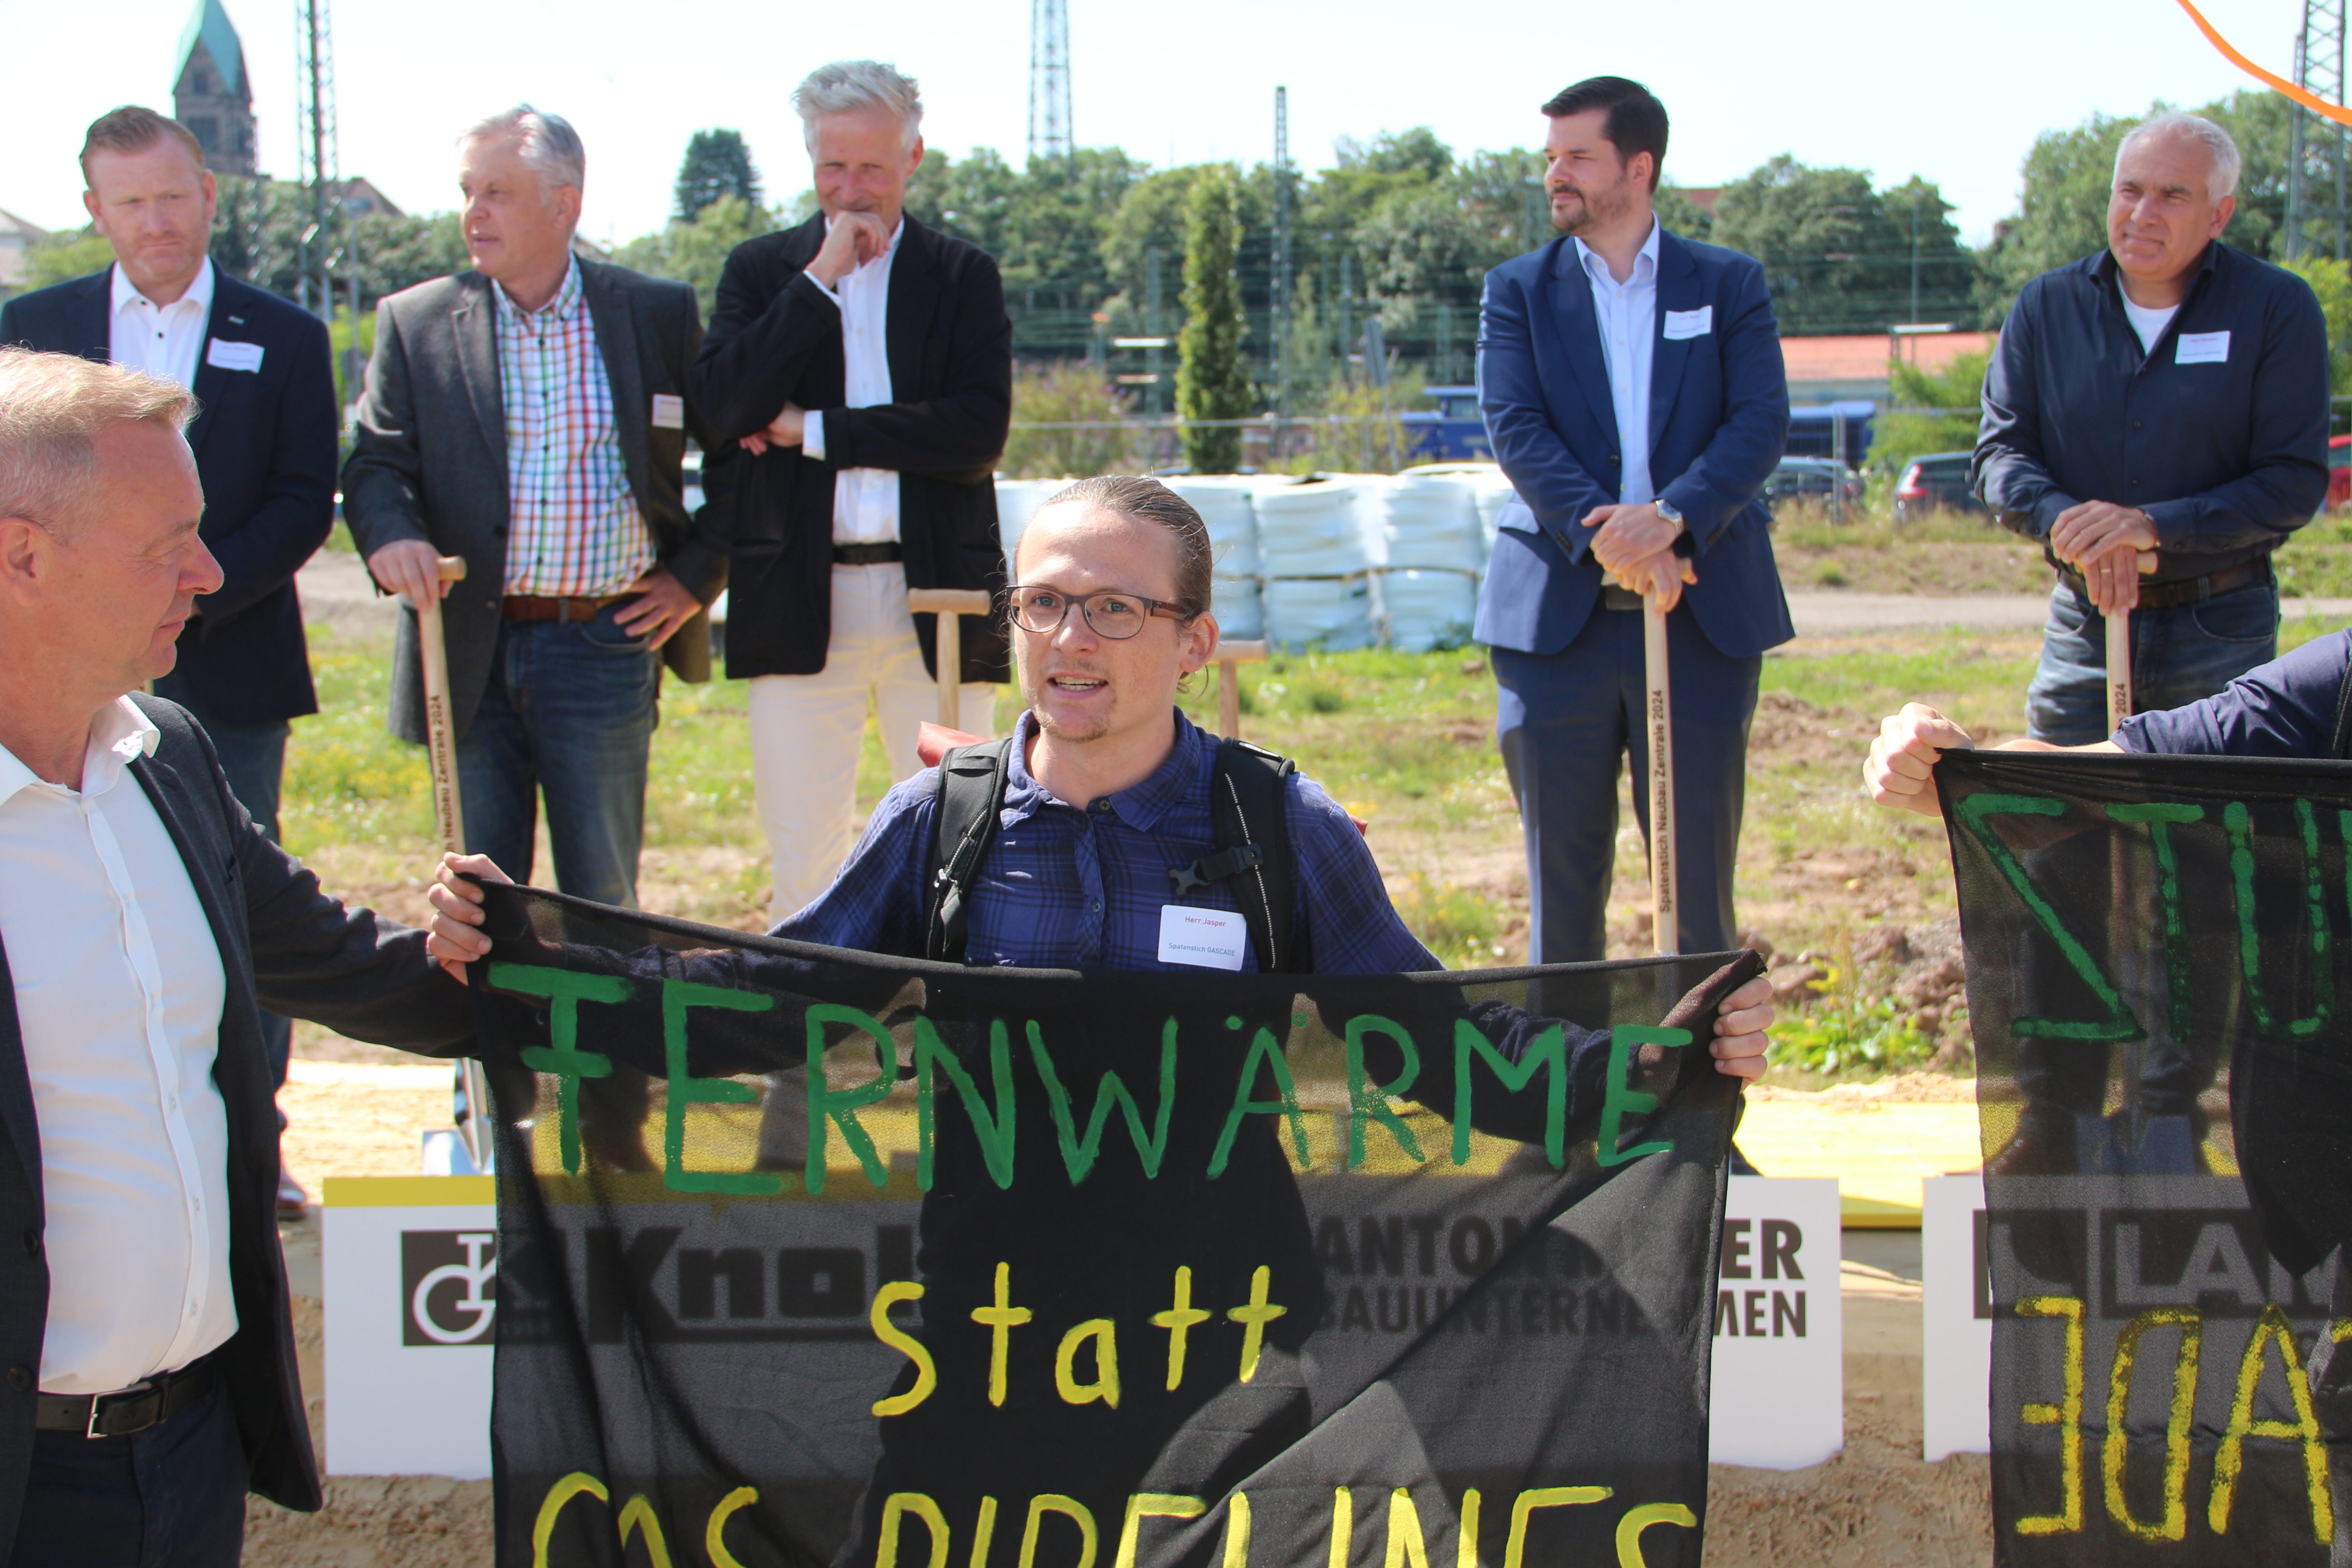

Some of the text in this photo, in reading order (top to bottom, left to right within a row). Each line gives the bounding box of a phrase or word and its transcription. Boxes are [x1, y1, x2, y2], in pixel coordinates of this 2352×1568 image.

[430, 694, 443, 725] 2024
[2115, 682, 2127, 713] 2024
[434, 730, 449, 783] Zentrale
[441, 788, 453, 838] Neubau
[1652, 689, 1671, 913] Spatenstich Neubau Zentrale 2024
[1185, 916, 1226, 927] Herr Jasper
[1168, 942, 1235, 956] Spatenstich GASCADE
[489, 964, 1693, 1196] FERNWÄRME
